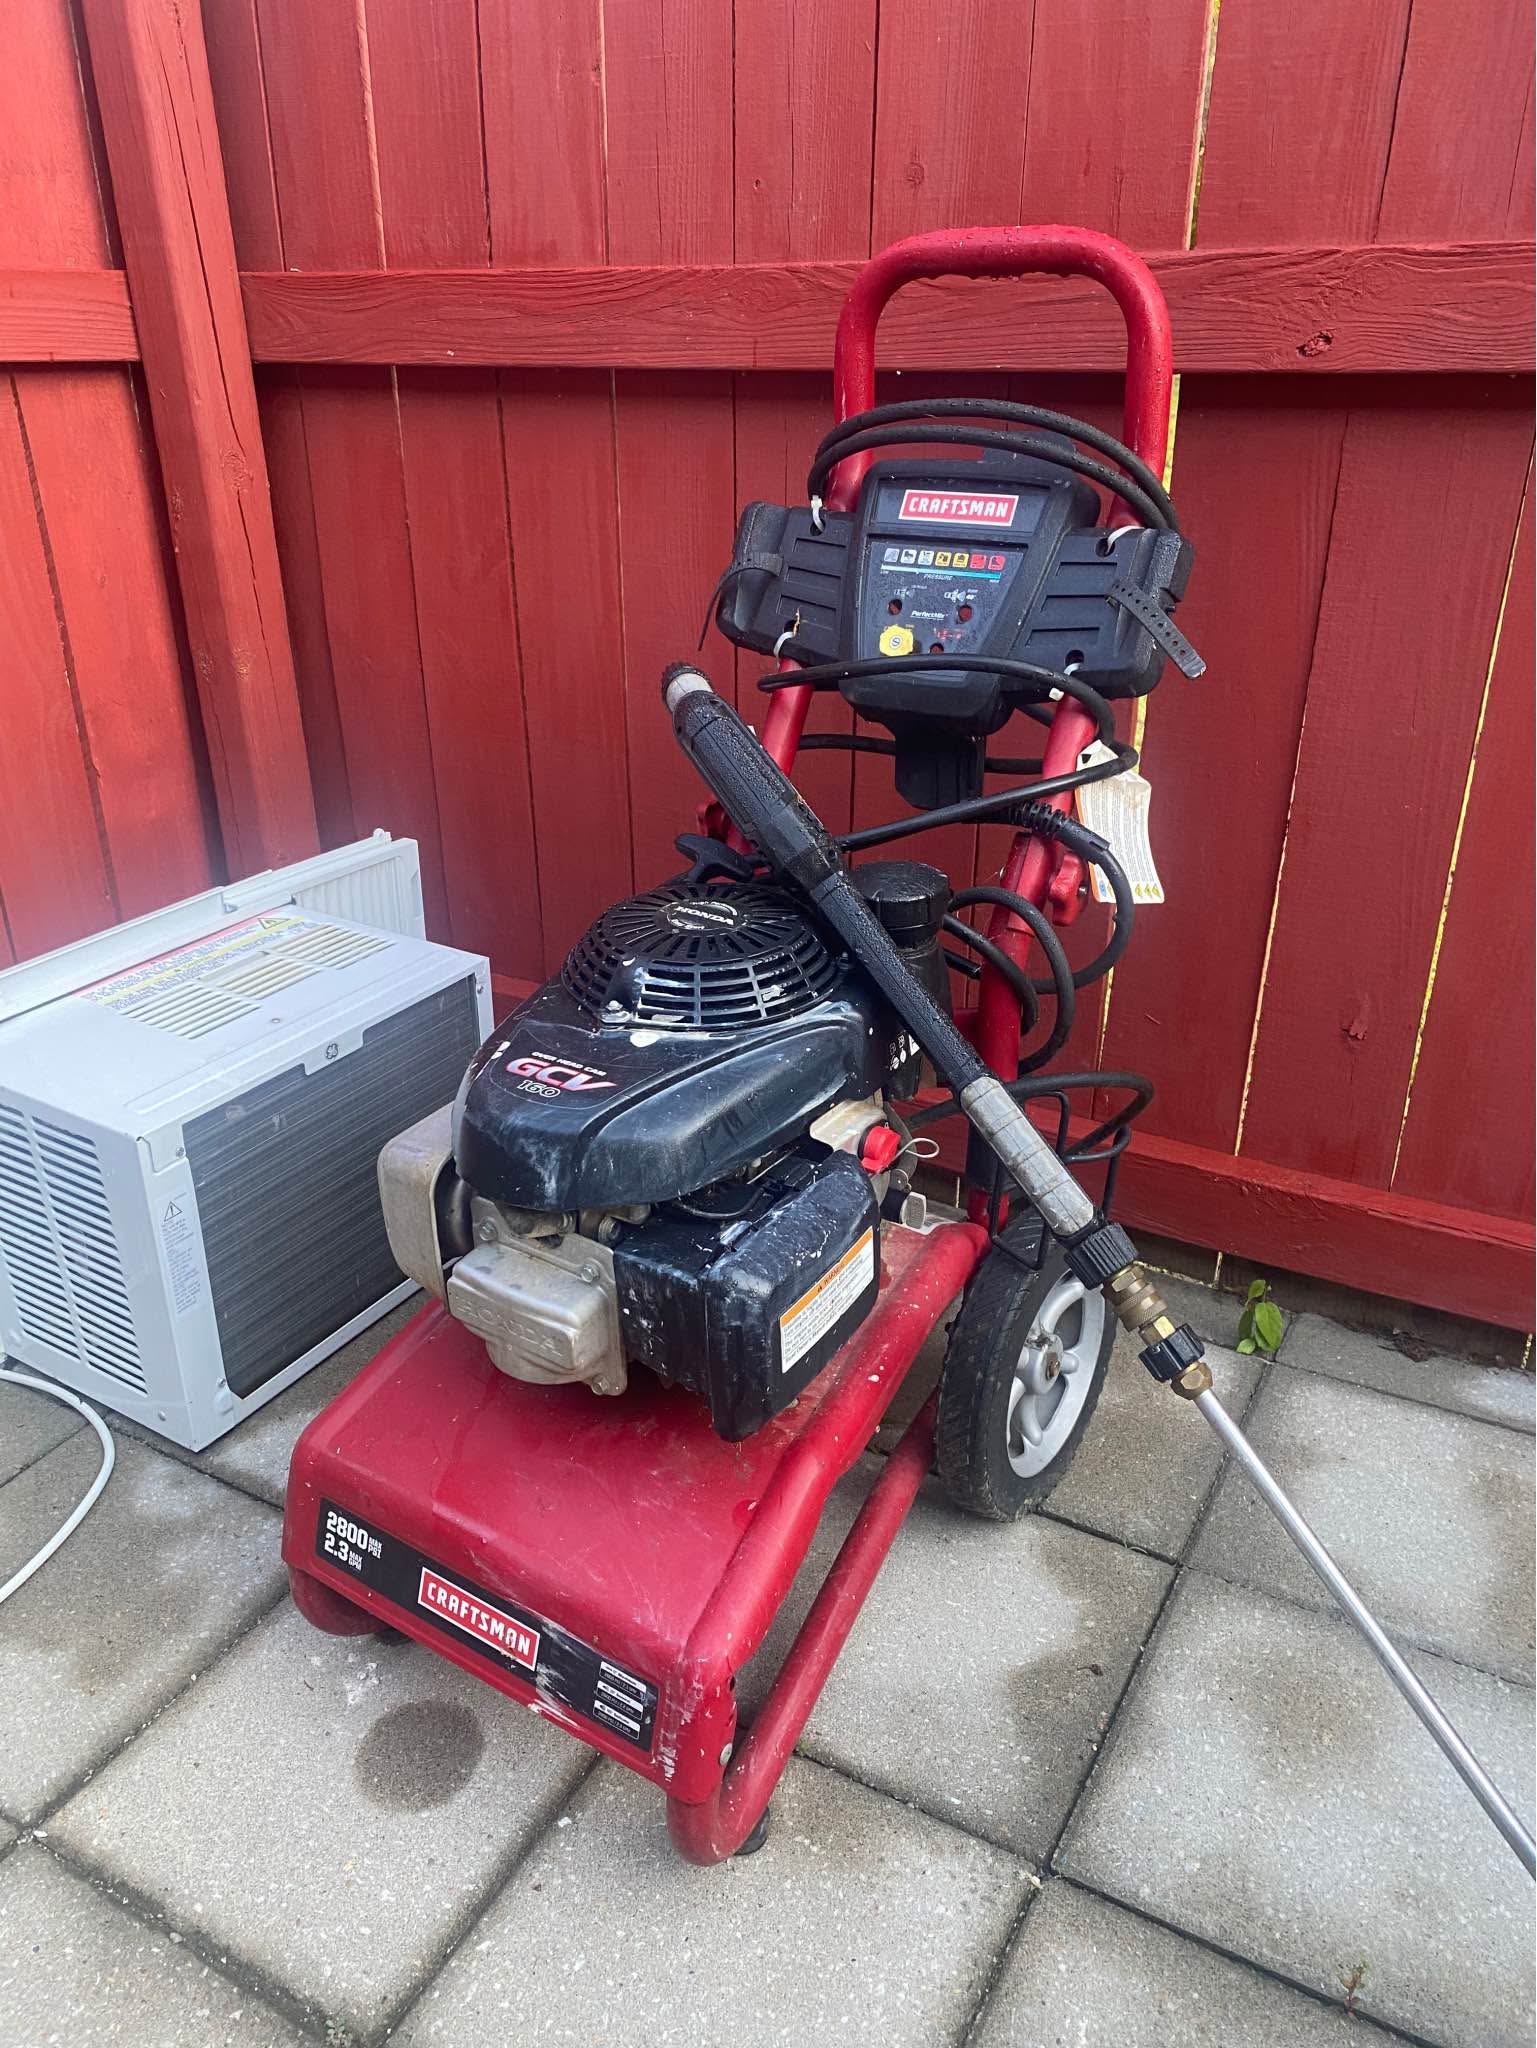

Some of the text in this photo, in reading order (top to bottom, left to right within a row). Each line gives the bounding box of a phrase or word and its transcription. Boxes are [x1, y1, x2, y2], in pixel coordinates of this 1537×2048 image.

[908, 497, 1009, 517] CRAFTSMAN
[674, 906, 734, 925] HONDA
[506, 1057, 618, 1091] GCV
[556, 1058, 584, 1069] HEAD
[583, 1066, 607, 1077] CAM
[517, 1079, 561, 1098] 160
[326, 1511, 382, 1559] 2800 MAX PSI
[324, 1532, 363, 1571] 2.3 MAX GPM
[427, 1582, 531, 1656] CRAFTSMAN
